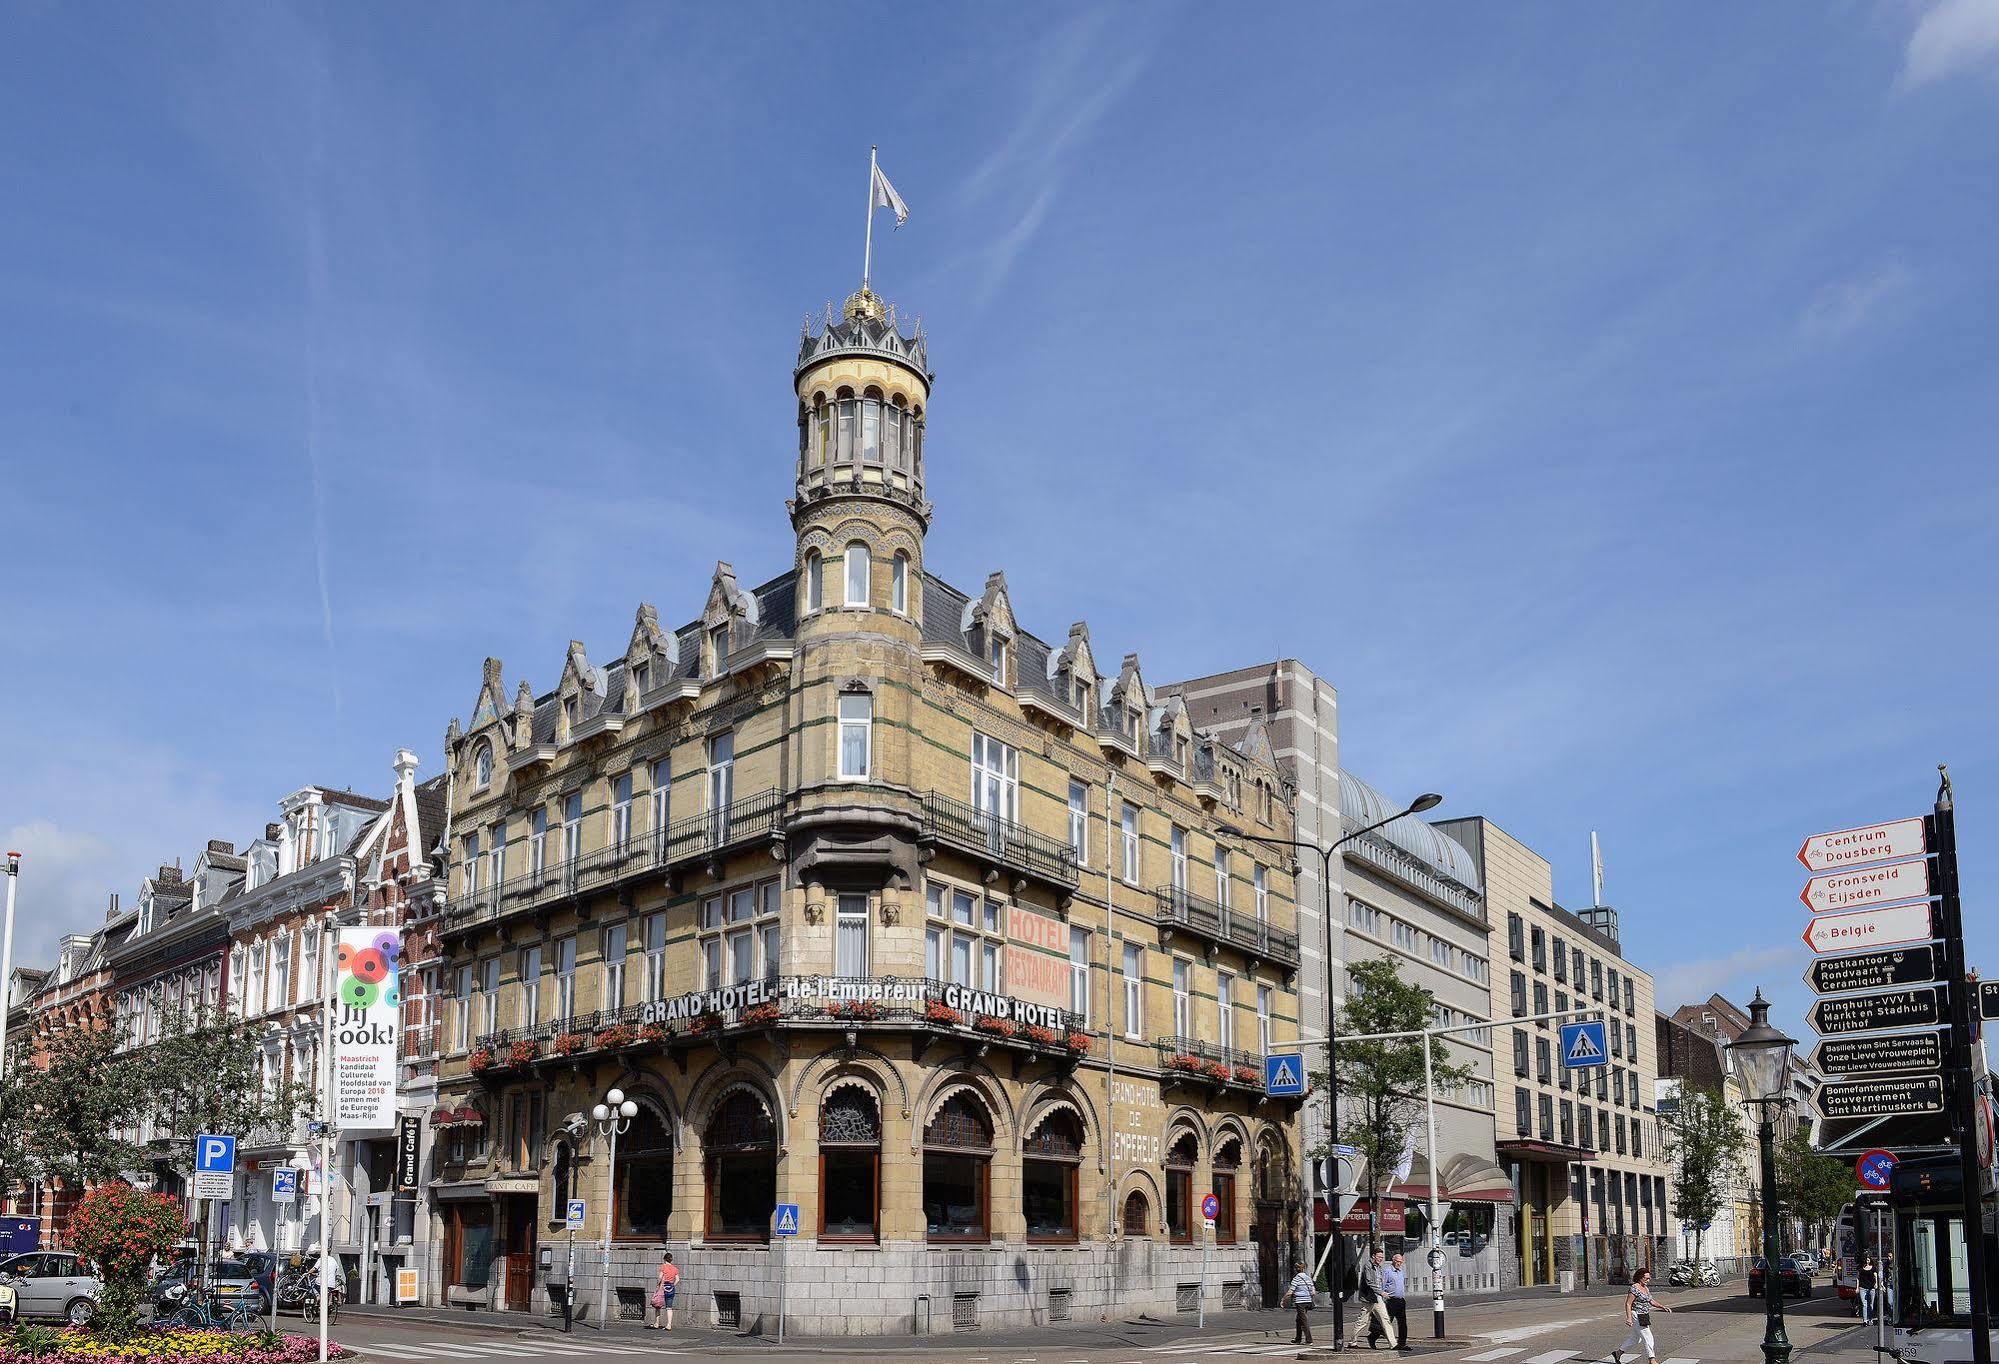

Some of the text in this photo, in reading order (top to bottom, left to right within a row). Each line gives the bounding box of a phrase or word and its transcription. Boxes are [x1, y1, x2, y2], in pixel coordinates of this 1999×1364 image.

[1825, 830, 1886, 847] Centrum
[1826, 844, 1892, 862] Dousberg
[1828, 868, 1899, 889] Gronsveld
[1829, 888, 1881, 904] Eijsden
[1009, 907, 1069, 952] HOTEL
[1831, 923, 1876, 938] België
[1820, 956, 1888, 971] Postkantoor
[1008, 948, 1071, 999] RESTAURANT
[1821, 966, 1879, 980] Rondvaart
[787, 978, 927, 1004] de l'Empereur
[1822, 976, 1882, 990] Ceramique
[643, 981, 770, 1024] GRAND HOTEL
[946, 986, 1066, 1030] GRAND HOTEL
[1824, 1002, 1929, 1021] Markt en Stadhuis
[340, 1022, 394, 1045] ook!
[1825, 1019, 1869, 1032] Vrijthof
[1826, 1043, 1856, 1052] Basiliek
[1873, 1041, 1890, 1049] Sint
[1891, 1038, 1925, 1047] Servaas
[1826, 1047, 1935, 1062] Onze Lieve Vrouweplein
[1827, 1064, 1846, 1072] Onze
[1847, 1062, 1868, 1071] Lieve
[340, 1079, 377, 1087] Hoofdstad
[367, 1087, 386, 1095] 2018
[1826, 1081, 1925, 1095] Bonnefantenmuseum
[1137, 1084, 1160, 1109] HOTEL
[1827, 1091, 1912, 1104] Gouvernement
[340, 1103, 379, 1113] de Euregio
[340, 1112, 377, 1120] Maas-Rijn
[1828, 1101, 1924, 1115] Sint Martinuskerk
[1129, 1110, 1141, 1127] DE
[204, 1139, 227, 1168] P
[1112, 1131, 1160, 1163] EMPEREUR
[404, 1153, 414, 1185] Grand
